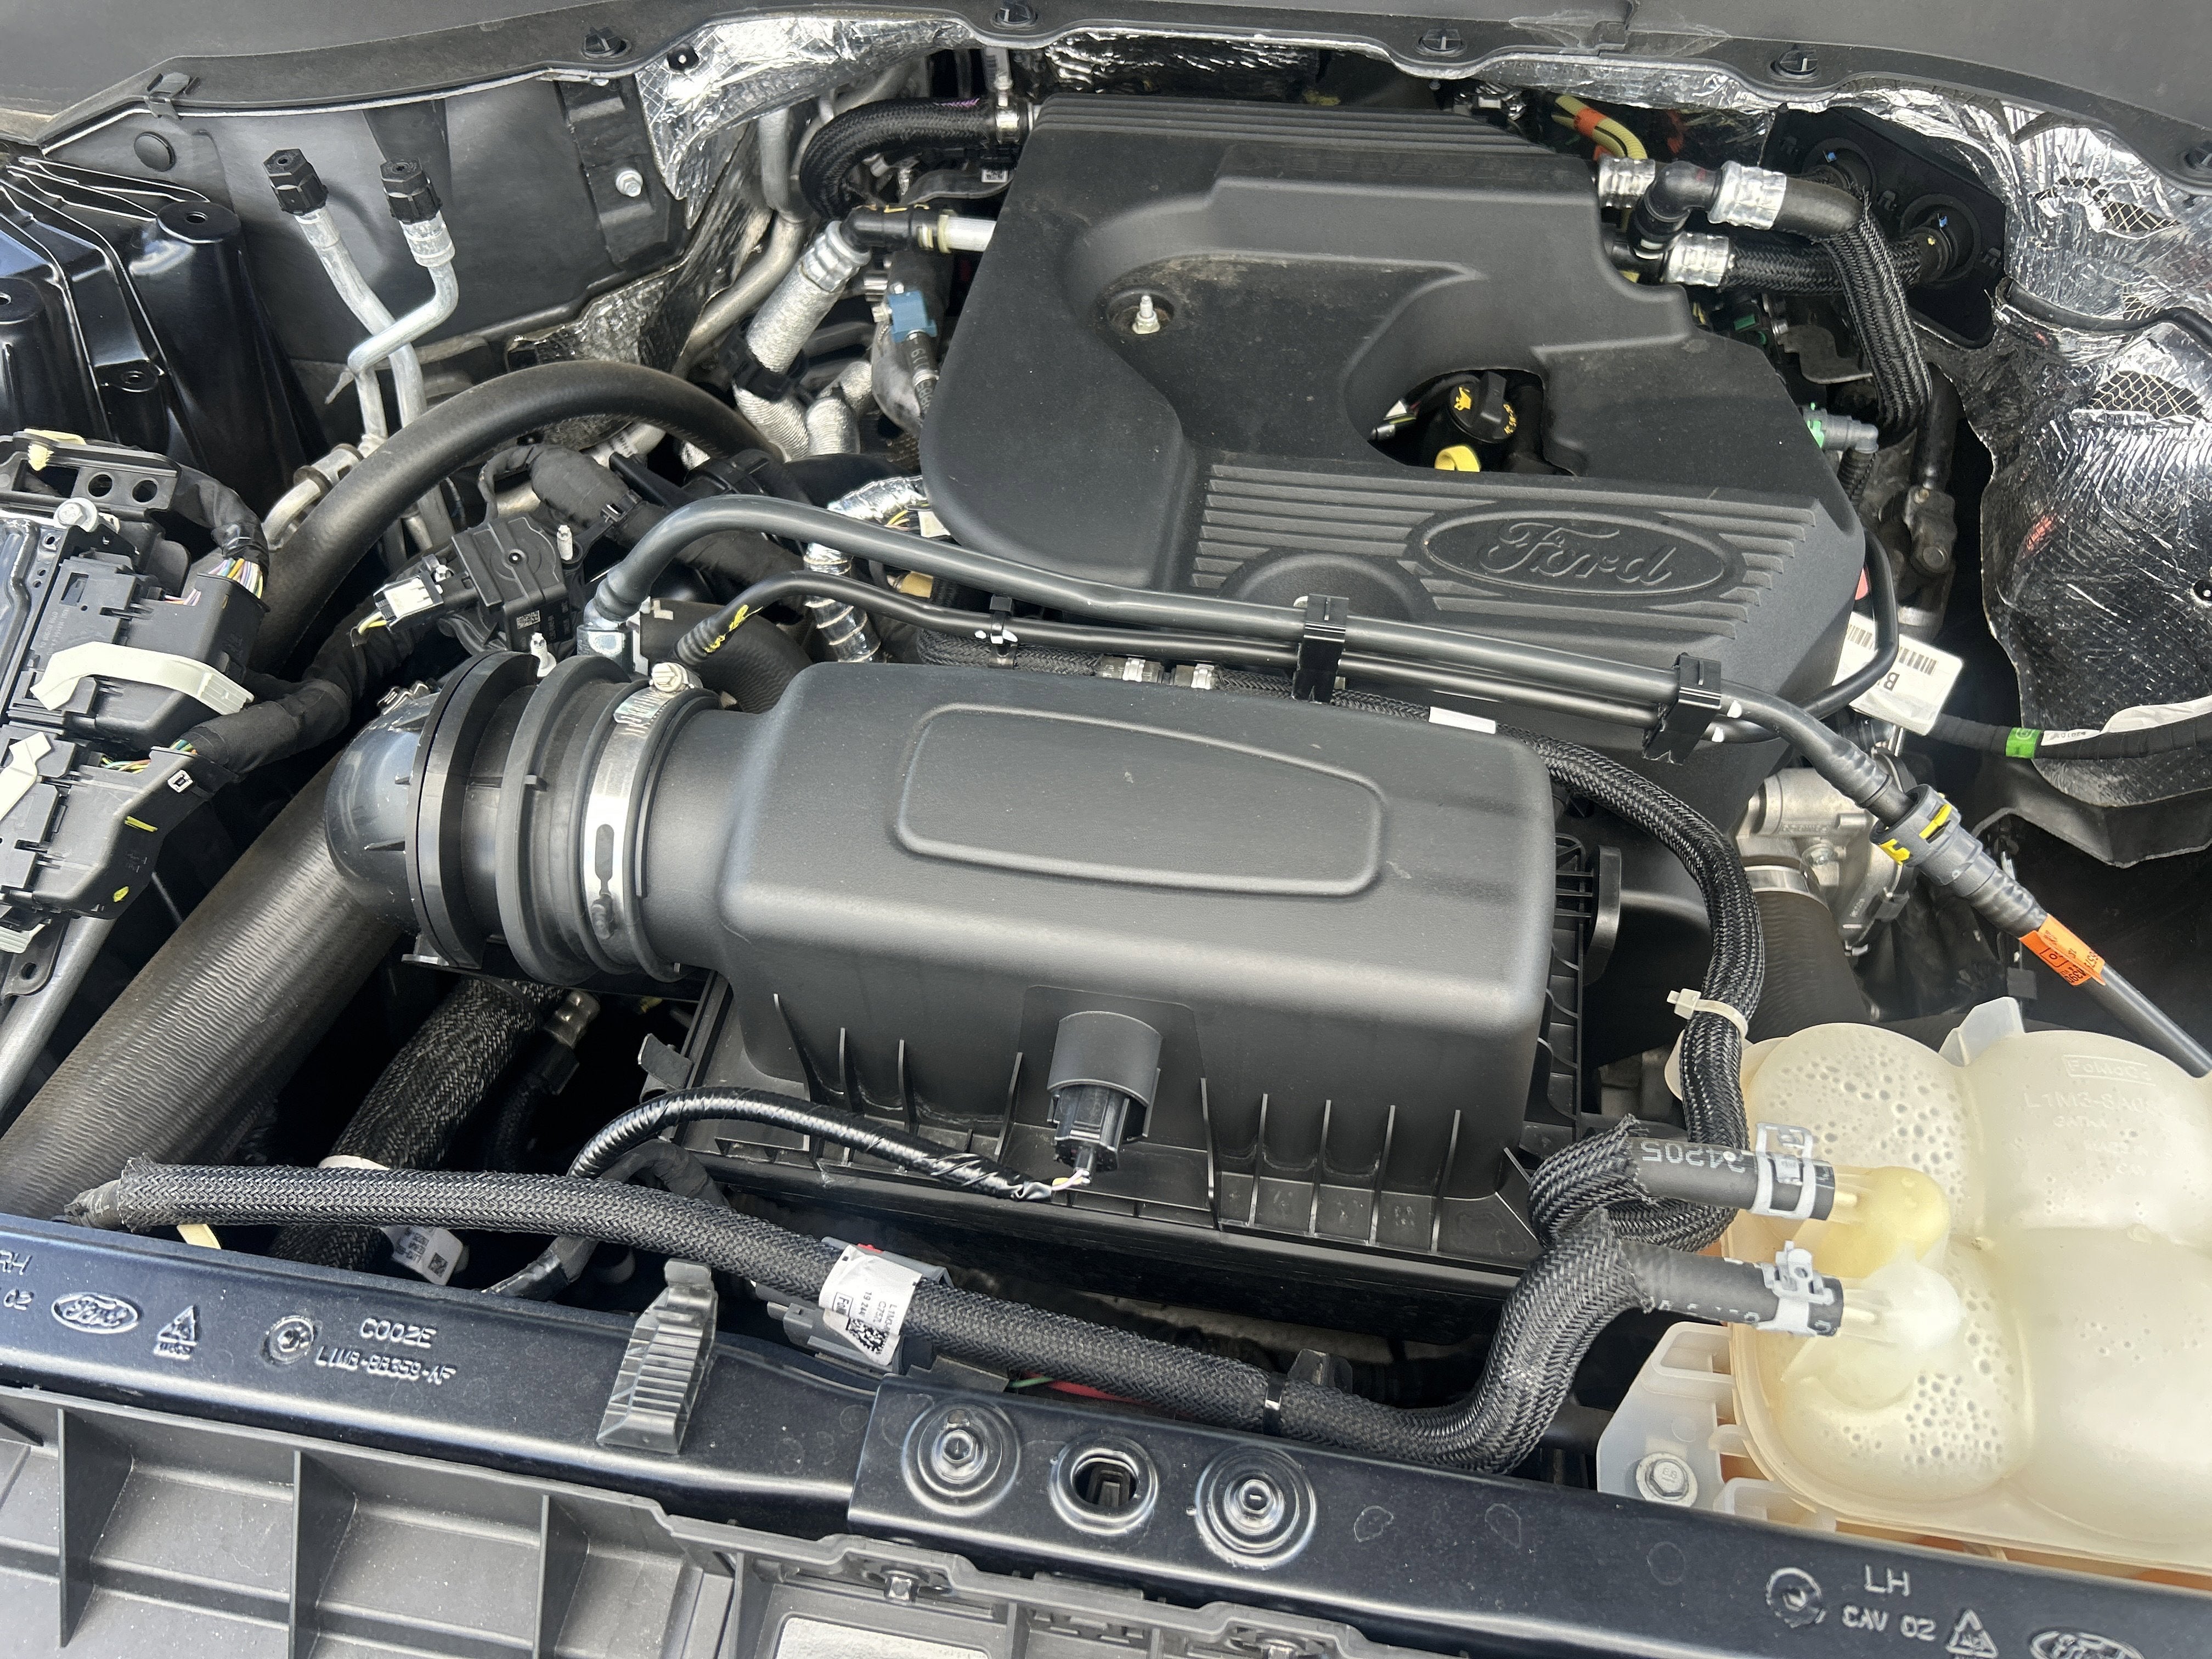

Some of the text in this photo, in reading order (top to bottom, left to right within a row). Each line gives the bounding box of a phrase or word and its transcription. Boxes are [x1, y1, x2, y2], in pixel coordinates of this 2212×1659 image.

[1479, 522, 1677, 586] Ford
[1865, 1565, 1910, 1597] LH
[1842, 1605, 1936, 1642] CAV 02
